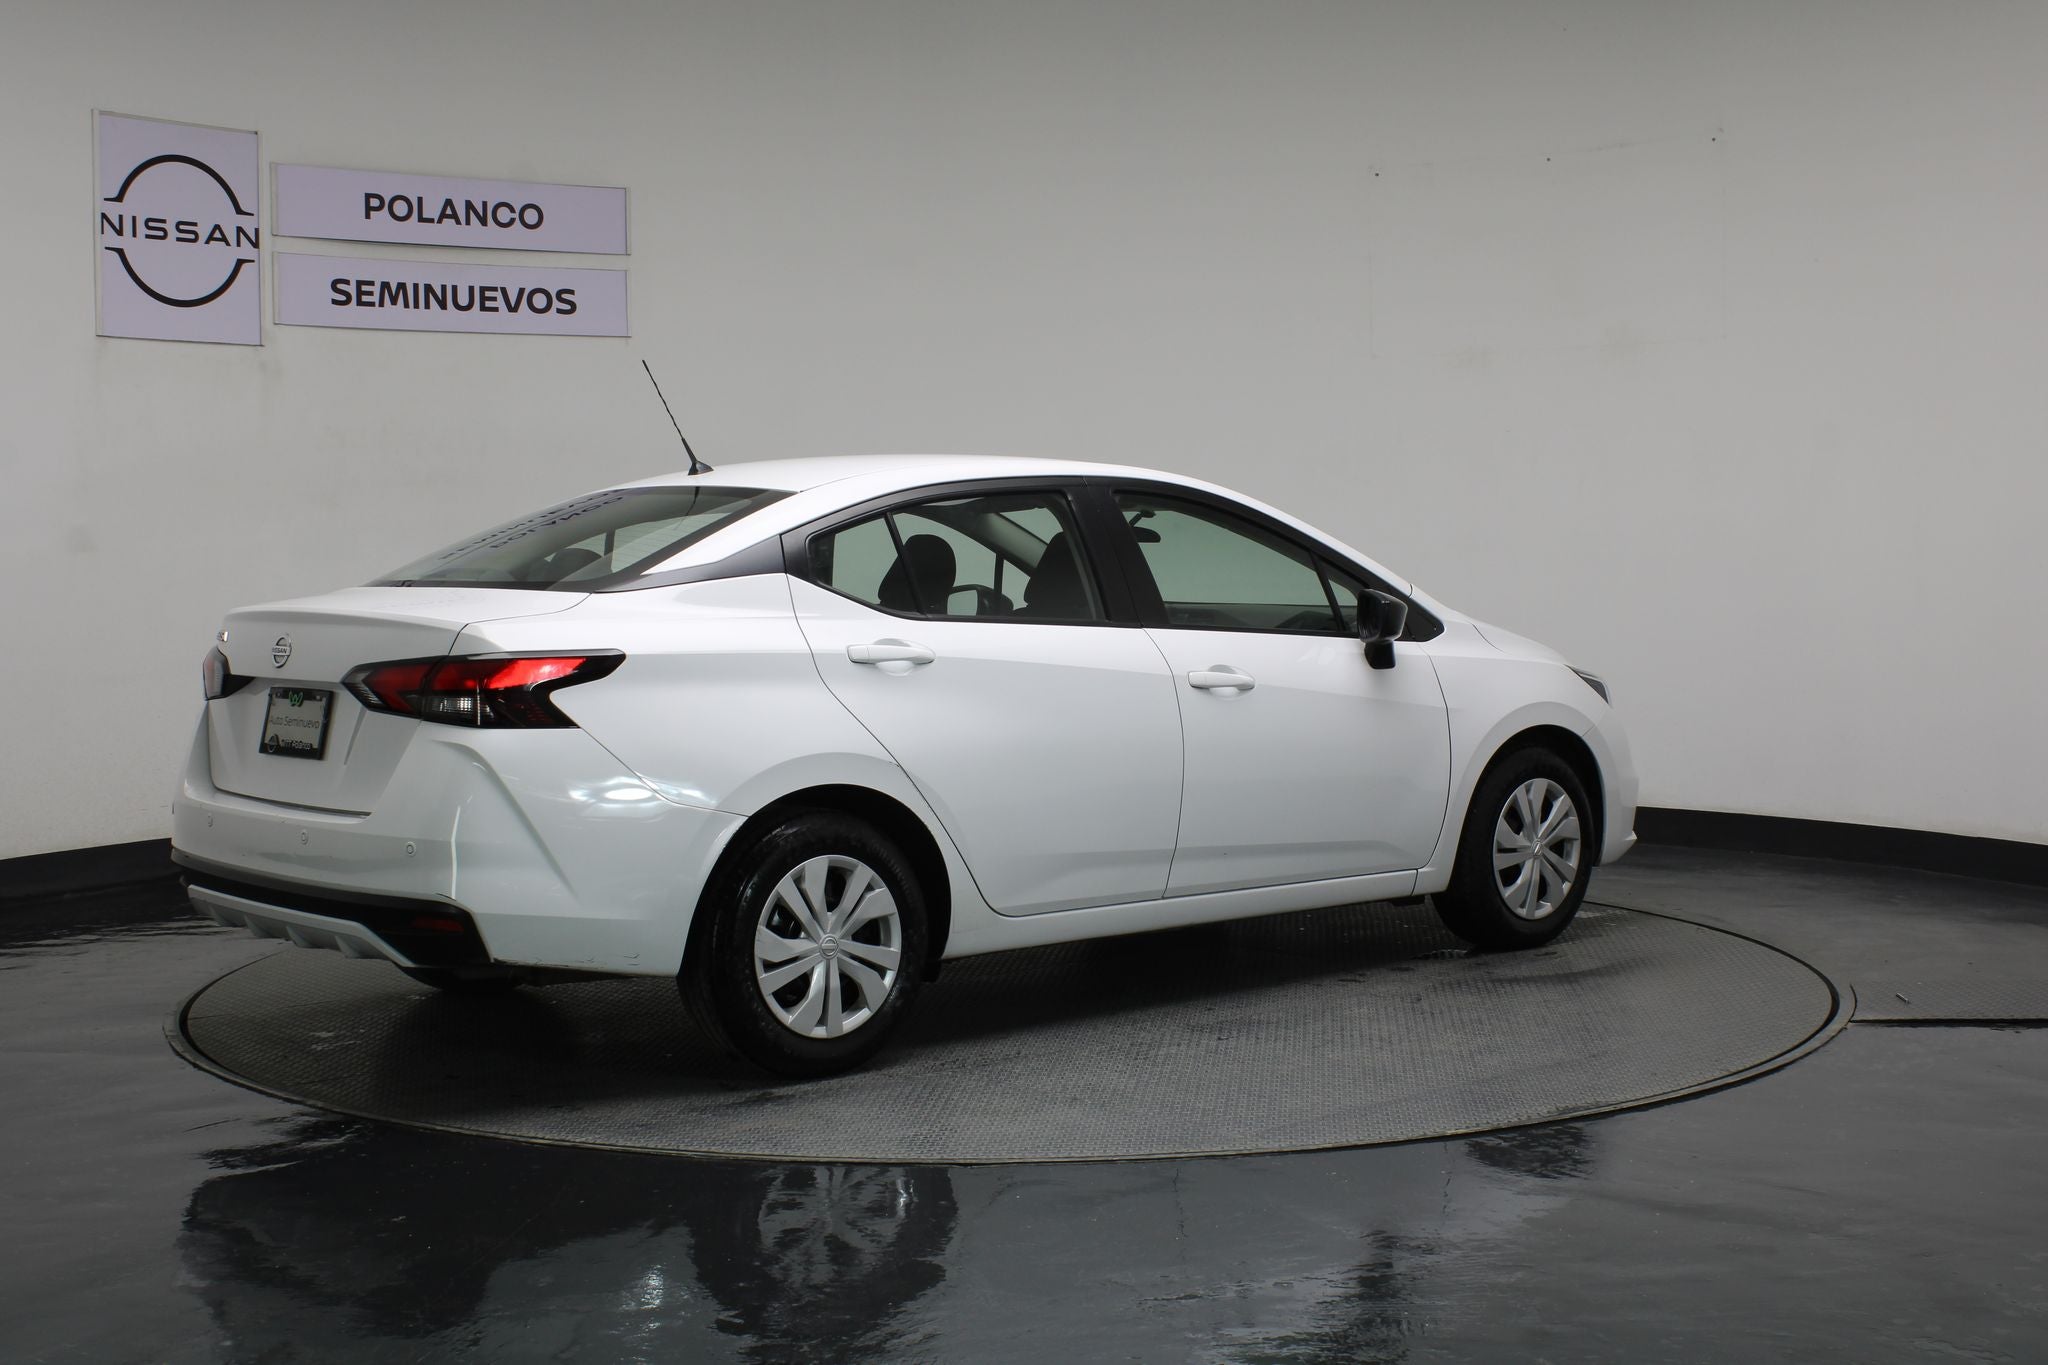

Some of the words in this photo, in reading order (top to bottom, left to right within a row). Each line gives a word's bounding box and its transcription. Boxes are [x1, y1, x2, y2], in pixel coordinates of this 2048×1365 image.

[364, 192, 544, 230] POLANCO
[101, 212, 260, 249] NISSAN
[330, 278, 578, 316] SEMINUEVOS
[283, 715, 320, 729] Seminuevo
